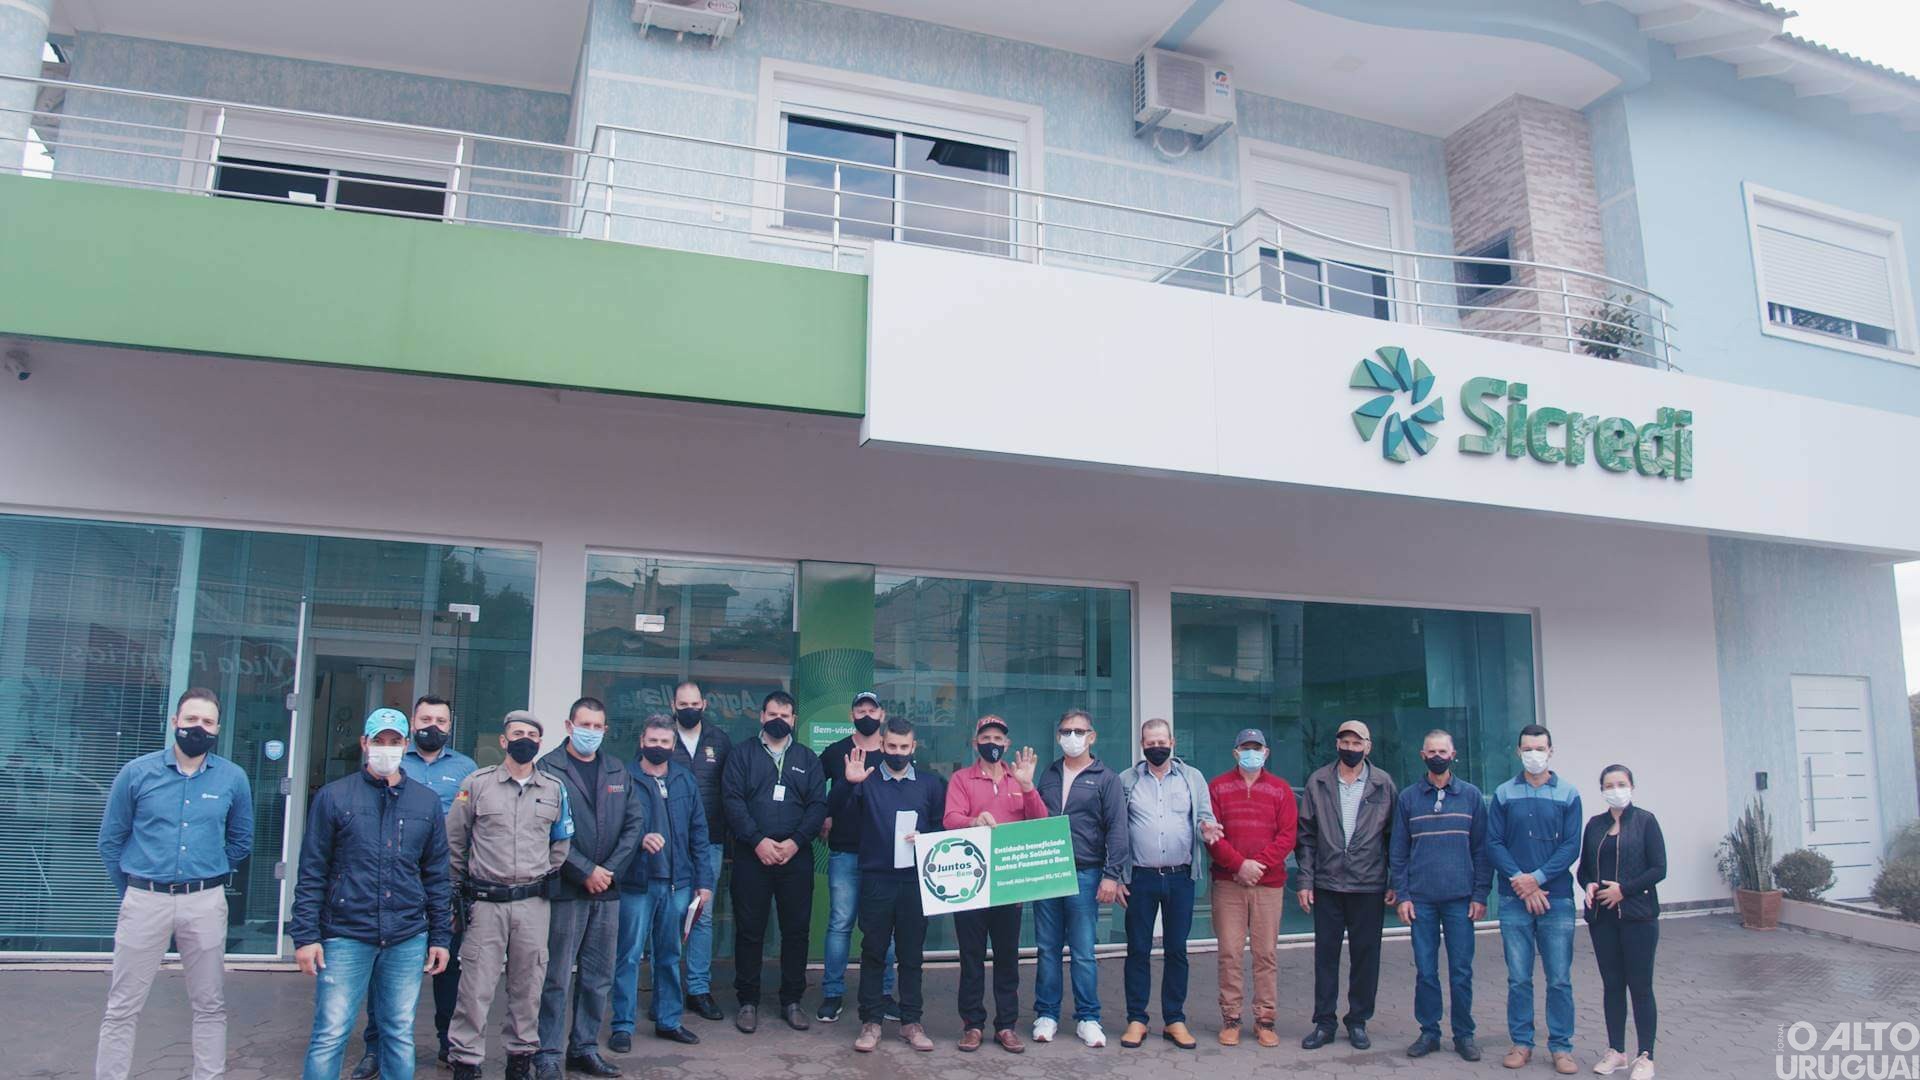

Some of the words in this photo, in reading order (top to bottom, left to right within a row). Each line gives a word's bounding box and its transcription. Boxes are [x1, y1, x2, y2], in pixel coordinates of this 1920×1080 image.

[1458, 376, 1692, 480] Sicredi
[994, 845, 1025, 854] Entidade
[937, 862, 972, 872] Juntos
